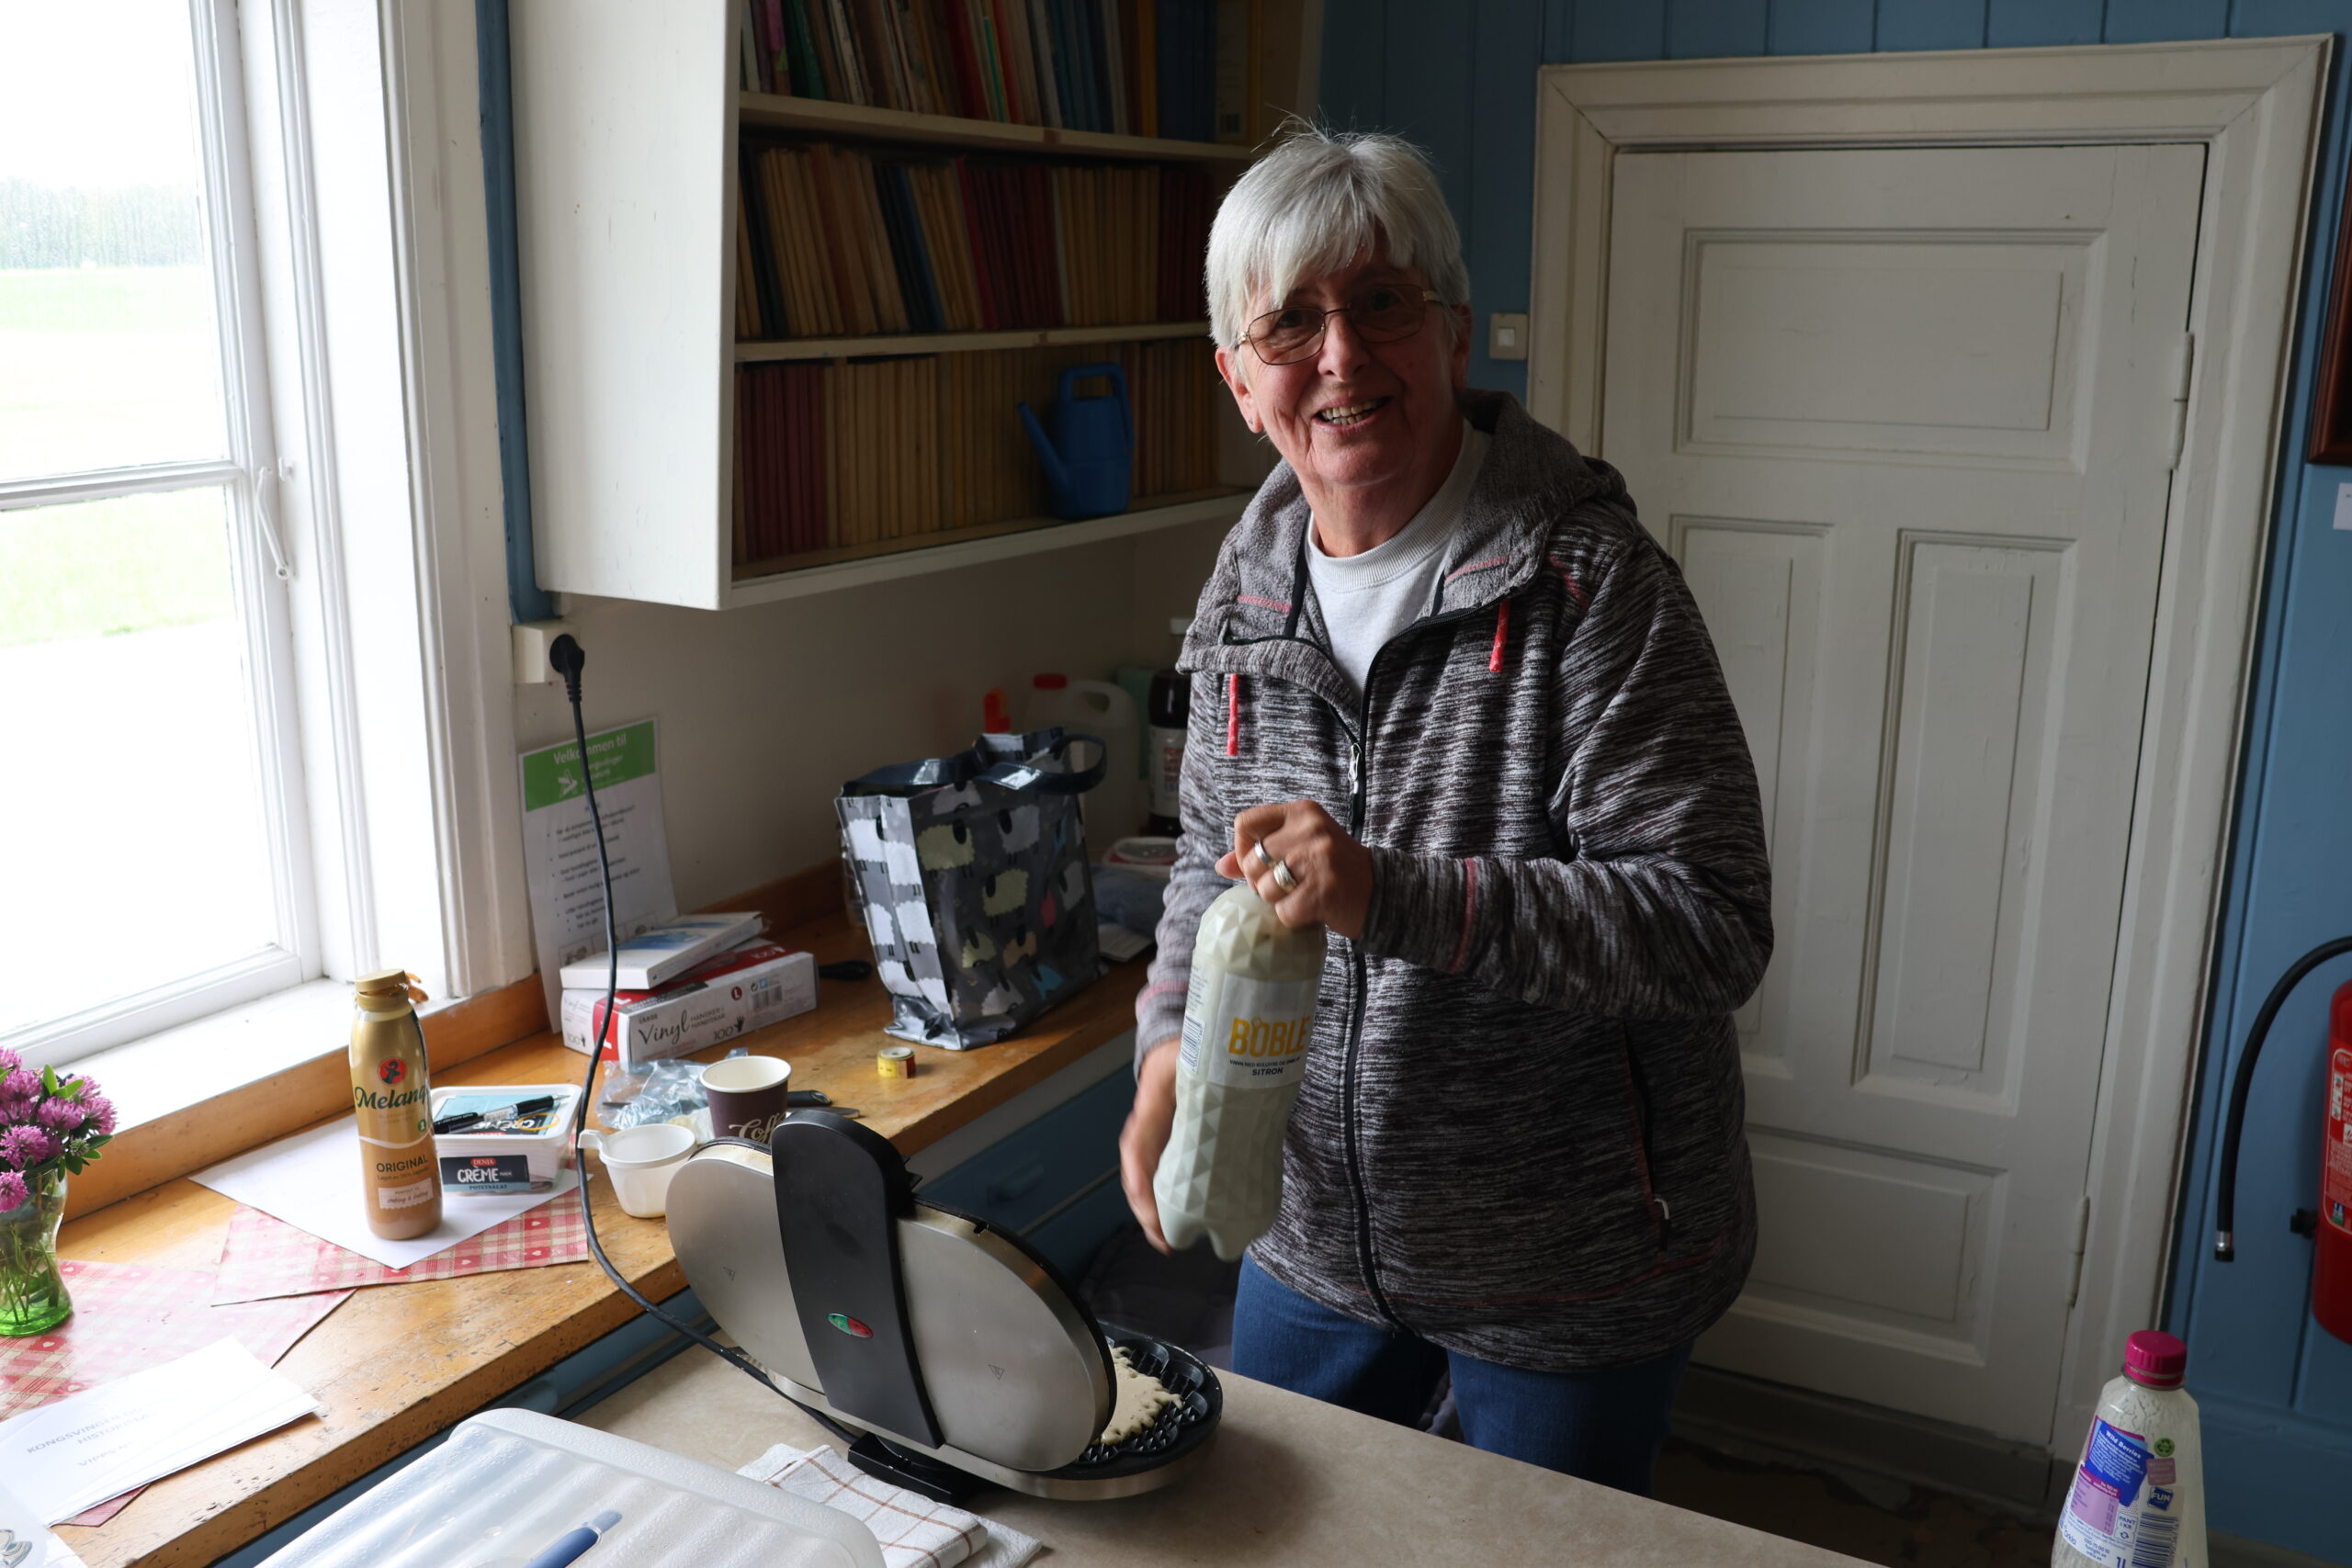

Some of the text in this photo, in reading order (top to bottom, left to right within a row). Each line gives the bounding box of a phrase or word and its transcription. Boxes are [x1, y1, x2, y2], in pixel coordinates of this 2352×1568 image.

[616, 733, 628, 747] til
[734, 987, 741, 999] L
[638, 1010, 690, 1045] Vinyl
[713, 1025, 734, 1042] 100
[1228, 1015, 1311, 1057] BOBLE
[1251, 1066, 1283, 1076] SITRON
[355, 1086, 429, 1110] Melang
[729, 1112, 784, 1145] Coff
[376, 1155, 428, 1173] ORIGINAL
[457, 1165, 500, 1183] CRÈME
[27, 1415, 121, 1454] KONGSVINGER
[2105, 1430, 2142, 1459] Wild Berries
[76, 1449, 118, 1467] VIPPS
[2151, 1492, 2171, 1503] FUN
[2119, 1516, 2136, 1525] PANT
